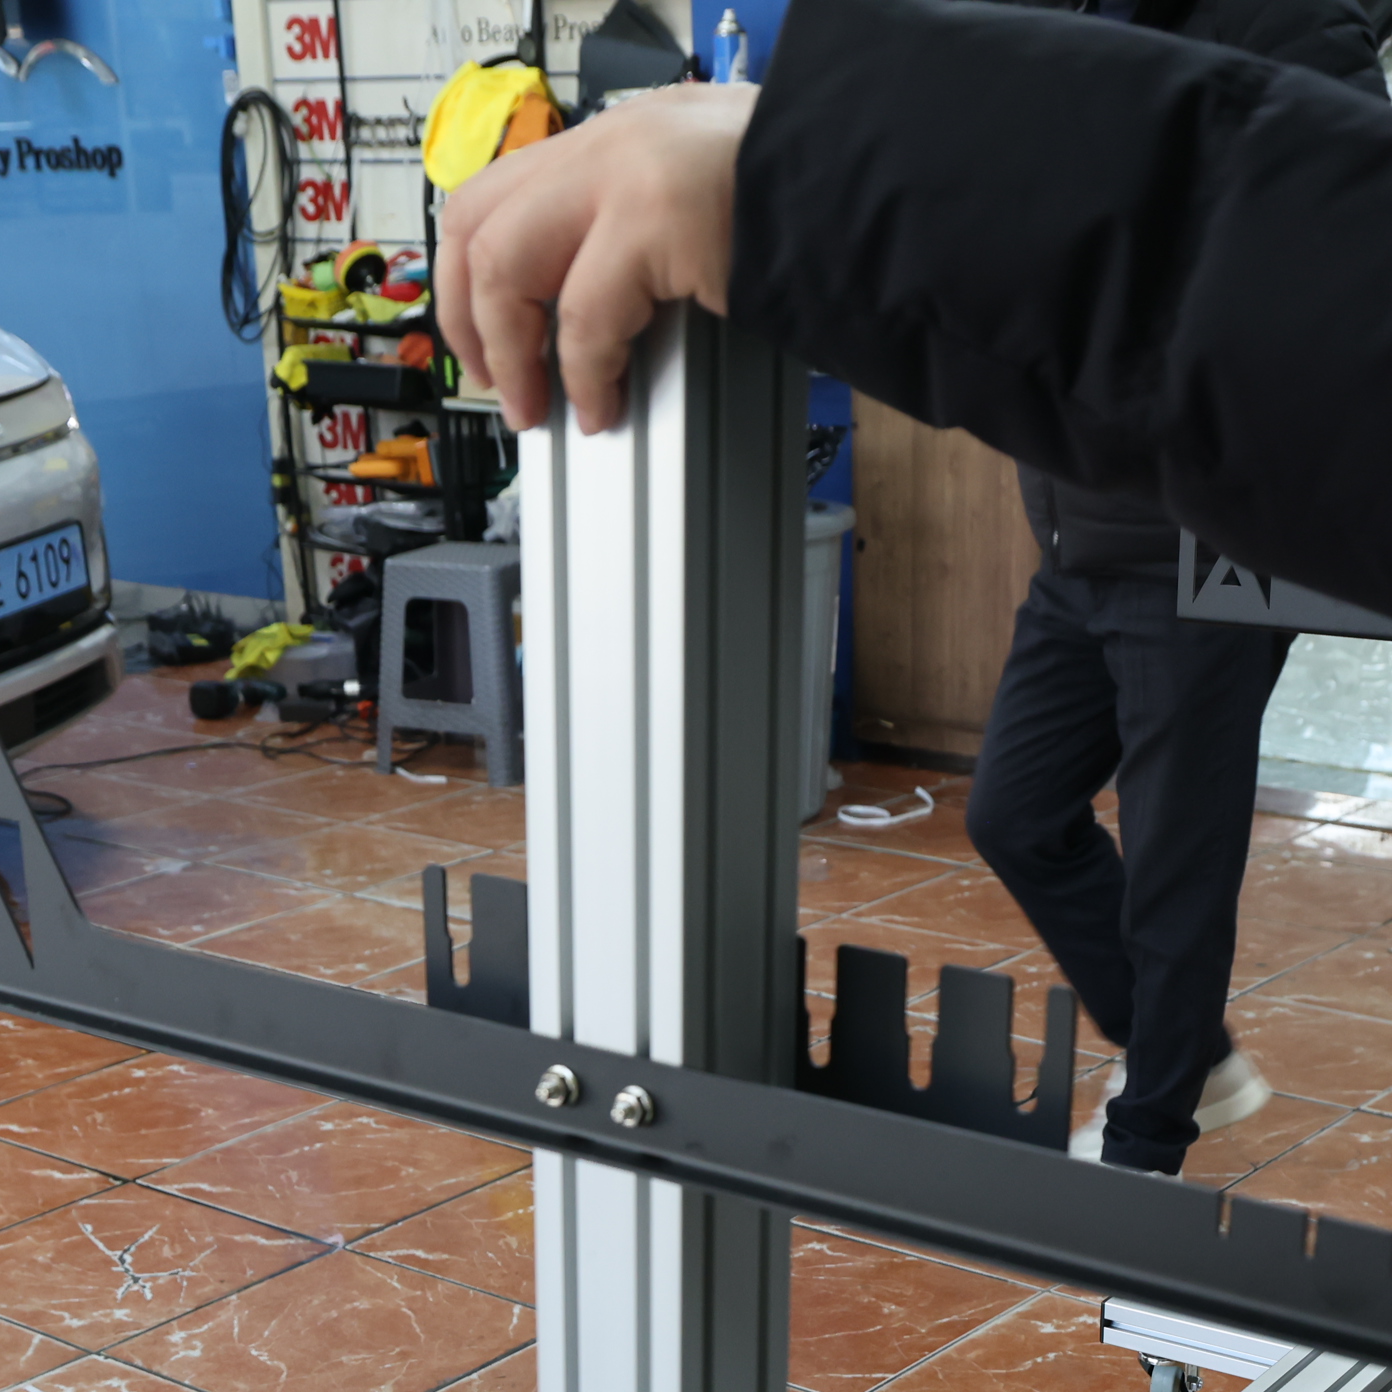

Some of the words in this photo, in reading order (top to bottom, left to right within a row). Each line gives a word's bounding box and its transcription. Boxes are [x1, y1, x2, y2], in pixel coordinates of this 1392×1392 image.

[285, 15, 339, 61] 3M
[292, 97, 345, 142] 3M
[15, 136, 123, 178] Proshop
[298, 178, 350, 222] 3M
[319, 410, 367, 450] 3M
[16, 537, 72, 599] 6109
